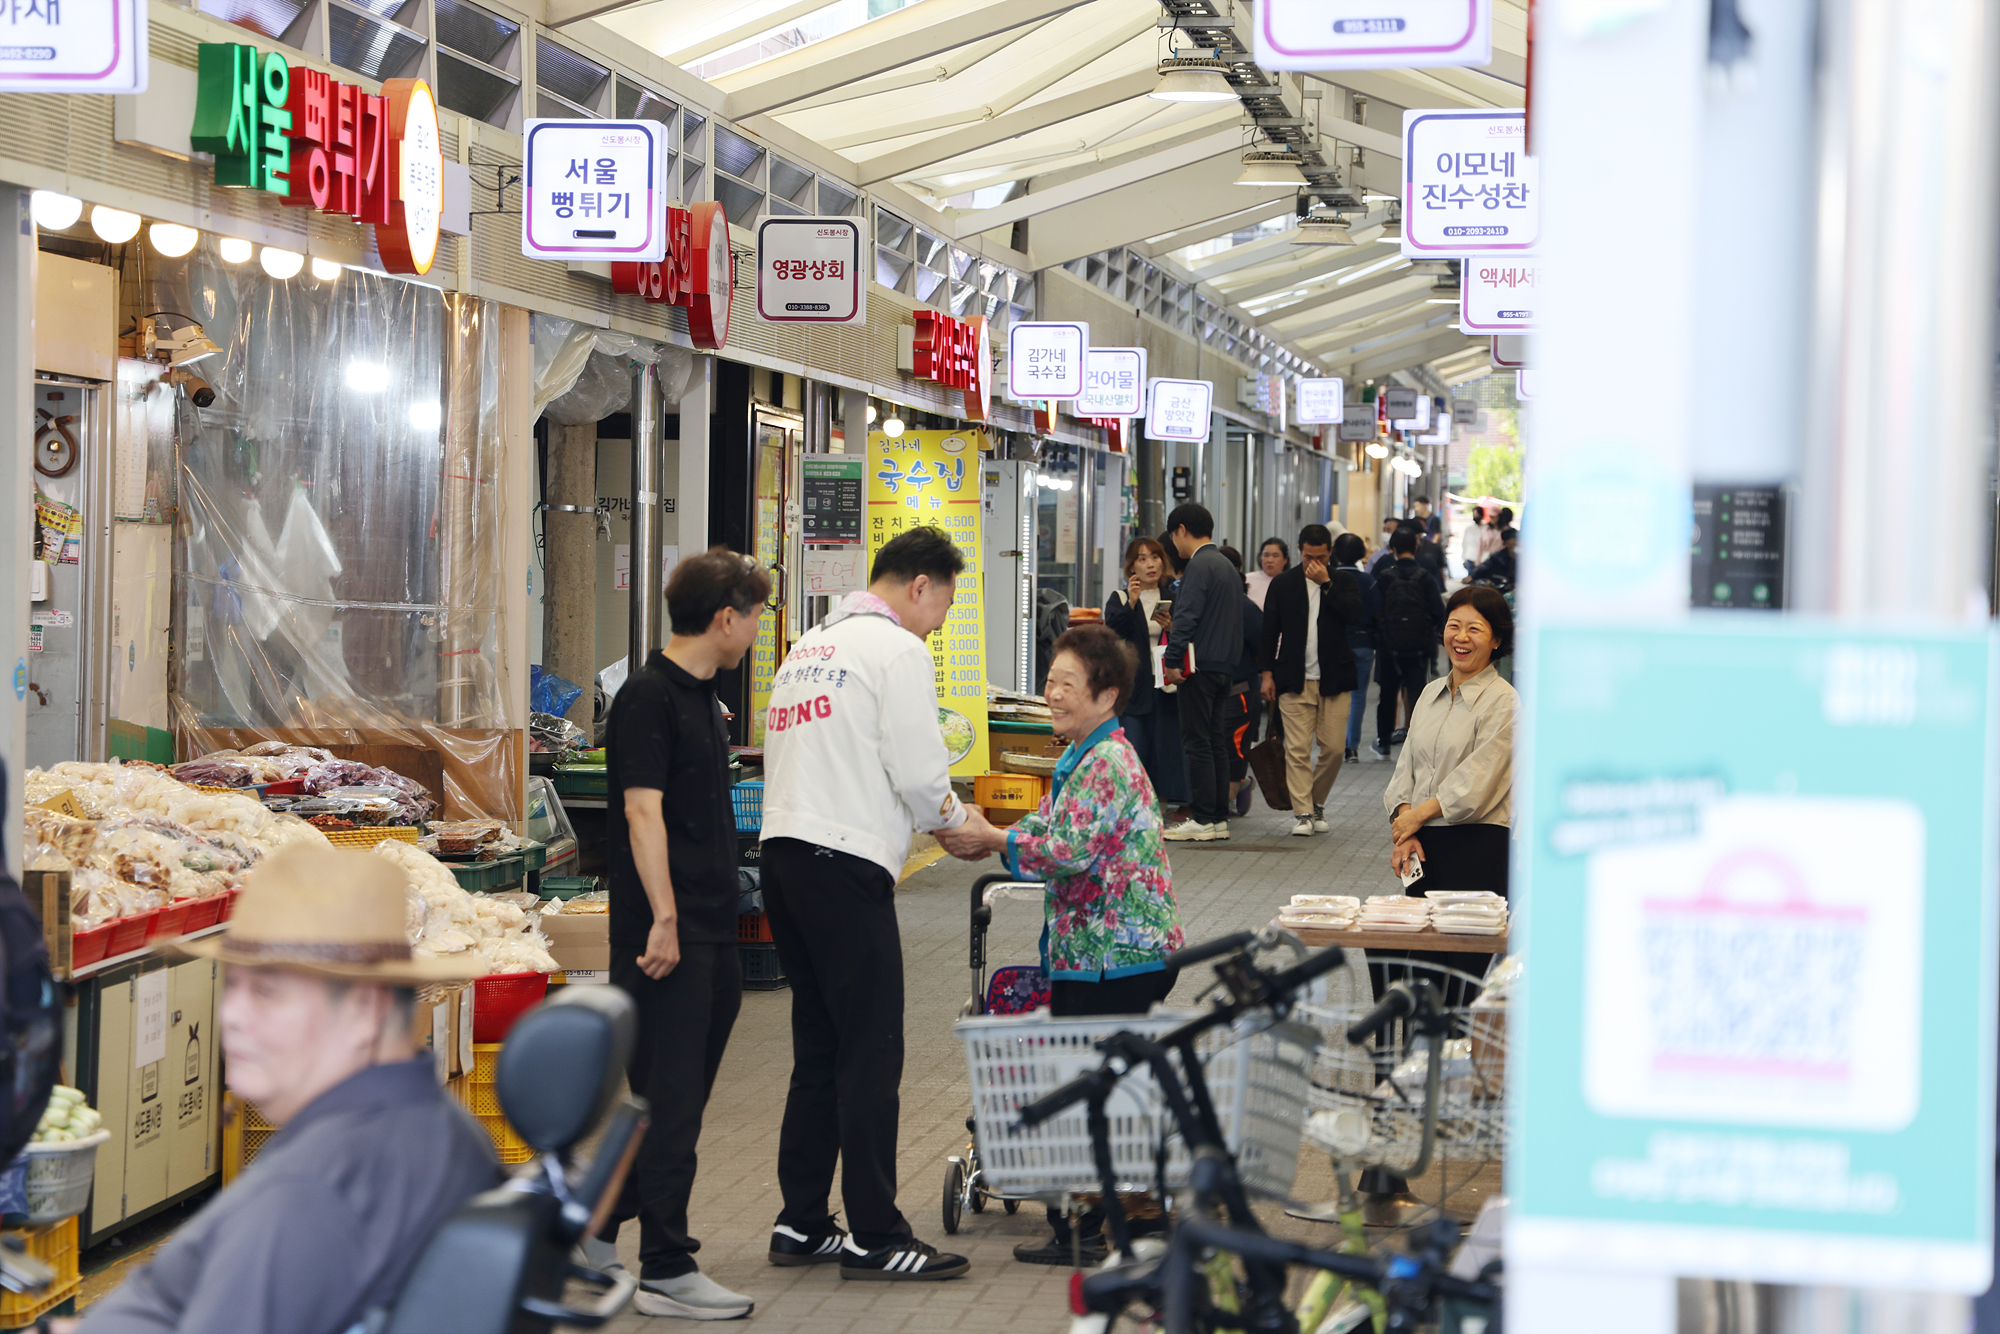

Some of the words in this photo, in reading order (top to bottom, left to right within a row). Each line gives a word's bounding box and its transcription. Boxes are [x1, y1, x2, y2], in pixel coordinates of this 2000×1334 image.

[226, 43, 293, 197] 서울
[303, 68, 390, 226] 뻥튀기
[601, 135, 641, 145] 신도봉시장
[565, 158, 618, 185] 서울
[1437, 151, 1515, 178] 이모네
[1421, 183, 1530, 210] 진수성찬
[551, 191, 631, 219] 뻥튀기
[816, 229, 849, 237] 신도봉시장
[1447, 227, 1505, 236] 010-2093-2418
[772, 260, 845, 281] 영광상회
[1479, 267, 1541, 288] 액세서
[1028, 348, 1066, 363] 김가네
[1027, 365, 1066, 379] 국수집
[1087, 370, 1134, 389] 건어물
[1164, 409, 1196, 422] 방앗간
[878, 438, 920, 454] 김가네
[876, 457, 965, 494] 국수집
[944, 515, 975, 528] 6,500
[948, 608, 978, 620] 6,500
[949, 623, 979, 636] 7,000
[949, 639, 980, 651] 3,000
[783, 643, 836, 665] obong
[950, 654, 980, 666] 4,000
[825, 668, 847, 688] 도봉
[950, 669, 981, 682] 4,000
[951, 685, 981, 697] 4,000
[769, 694, 832, 731] OBONG
